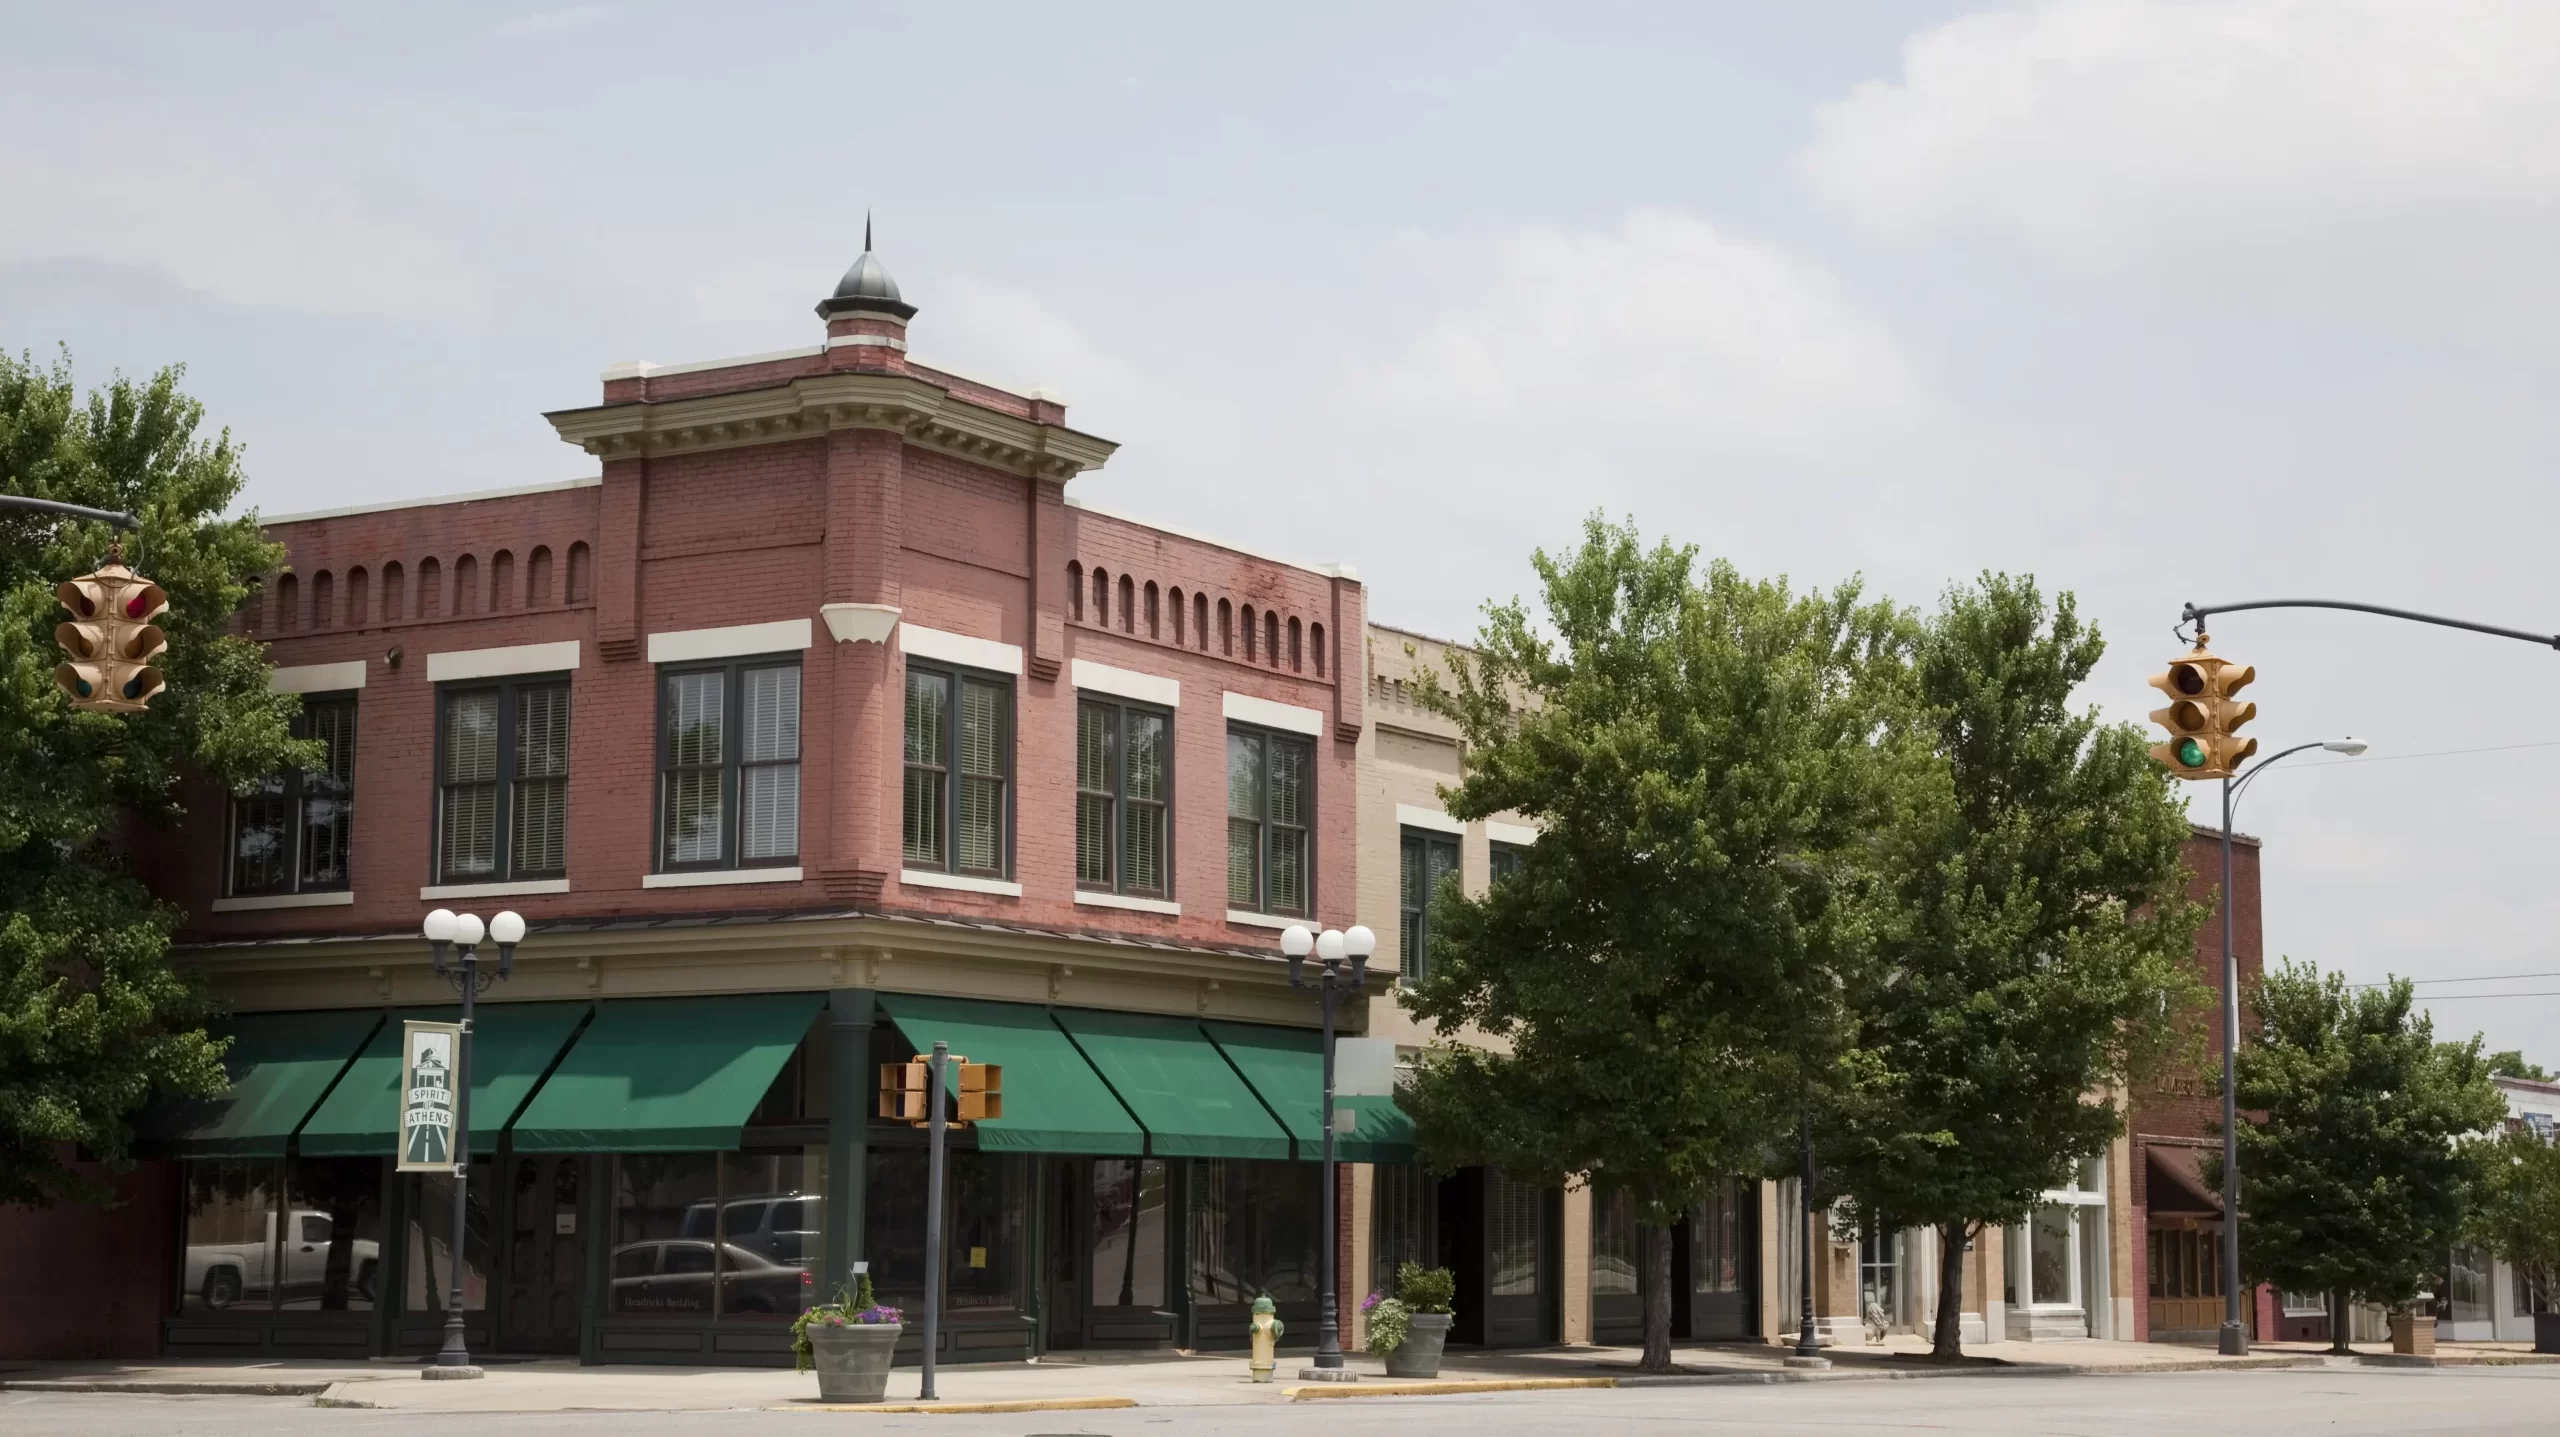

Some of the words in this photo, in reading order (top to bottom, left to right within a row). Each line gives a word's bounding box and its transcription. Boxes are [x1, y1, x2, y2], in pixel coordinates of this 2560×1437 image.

[415, 1089, 446, 1101] SPIRIT
[409, 1111, 449, 1124] ATHENS
[624, 1297, 664, 1306] Hendricks
[667, 1297, 700, 1309] Building
